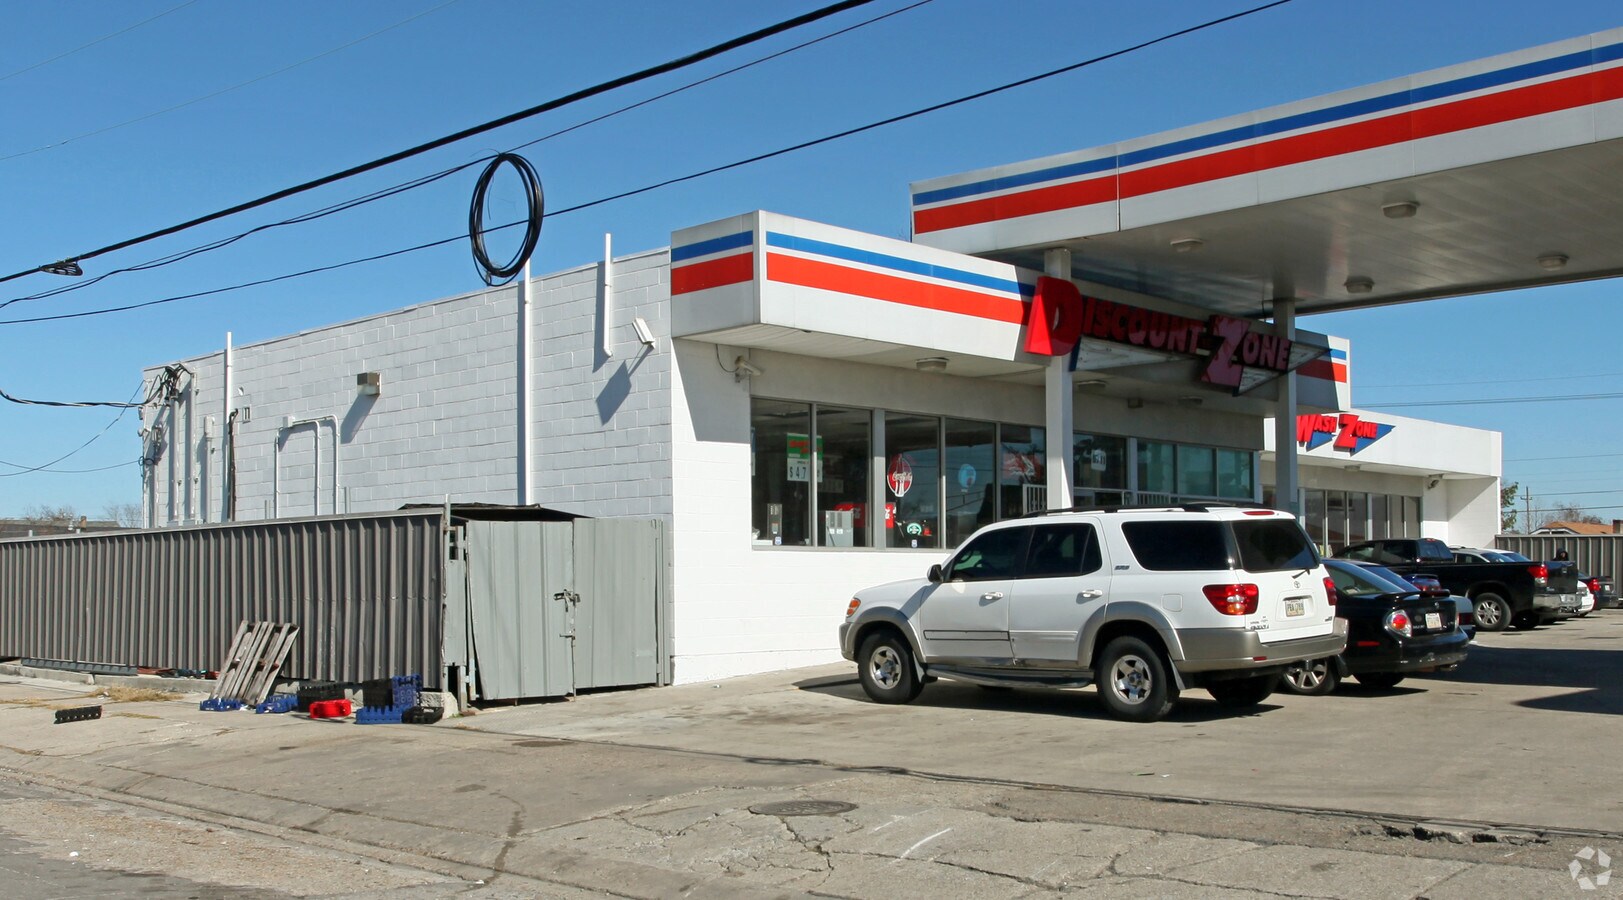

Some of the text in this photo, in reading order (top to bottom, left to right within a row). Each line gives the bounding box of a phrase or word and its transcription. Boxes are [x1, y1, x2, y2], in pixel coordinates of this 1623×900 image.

[1024, 276, 1291, 387] DISCOUNT ZONE
[1296, 413, 1378, 450] WASH ZONE
